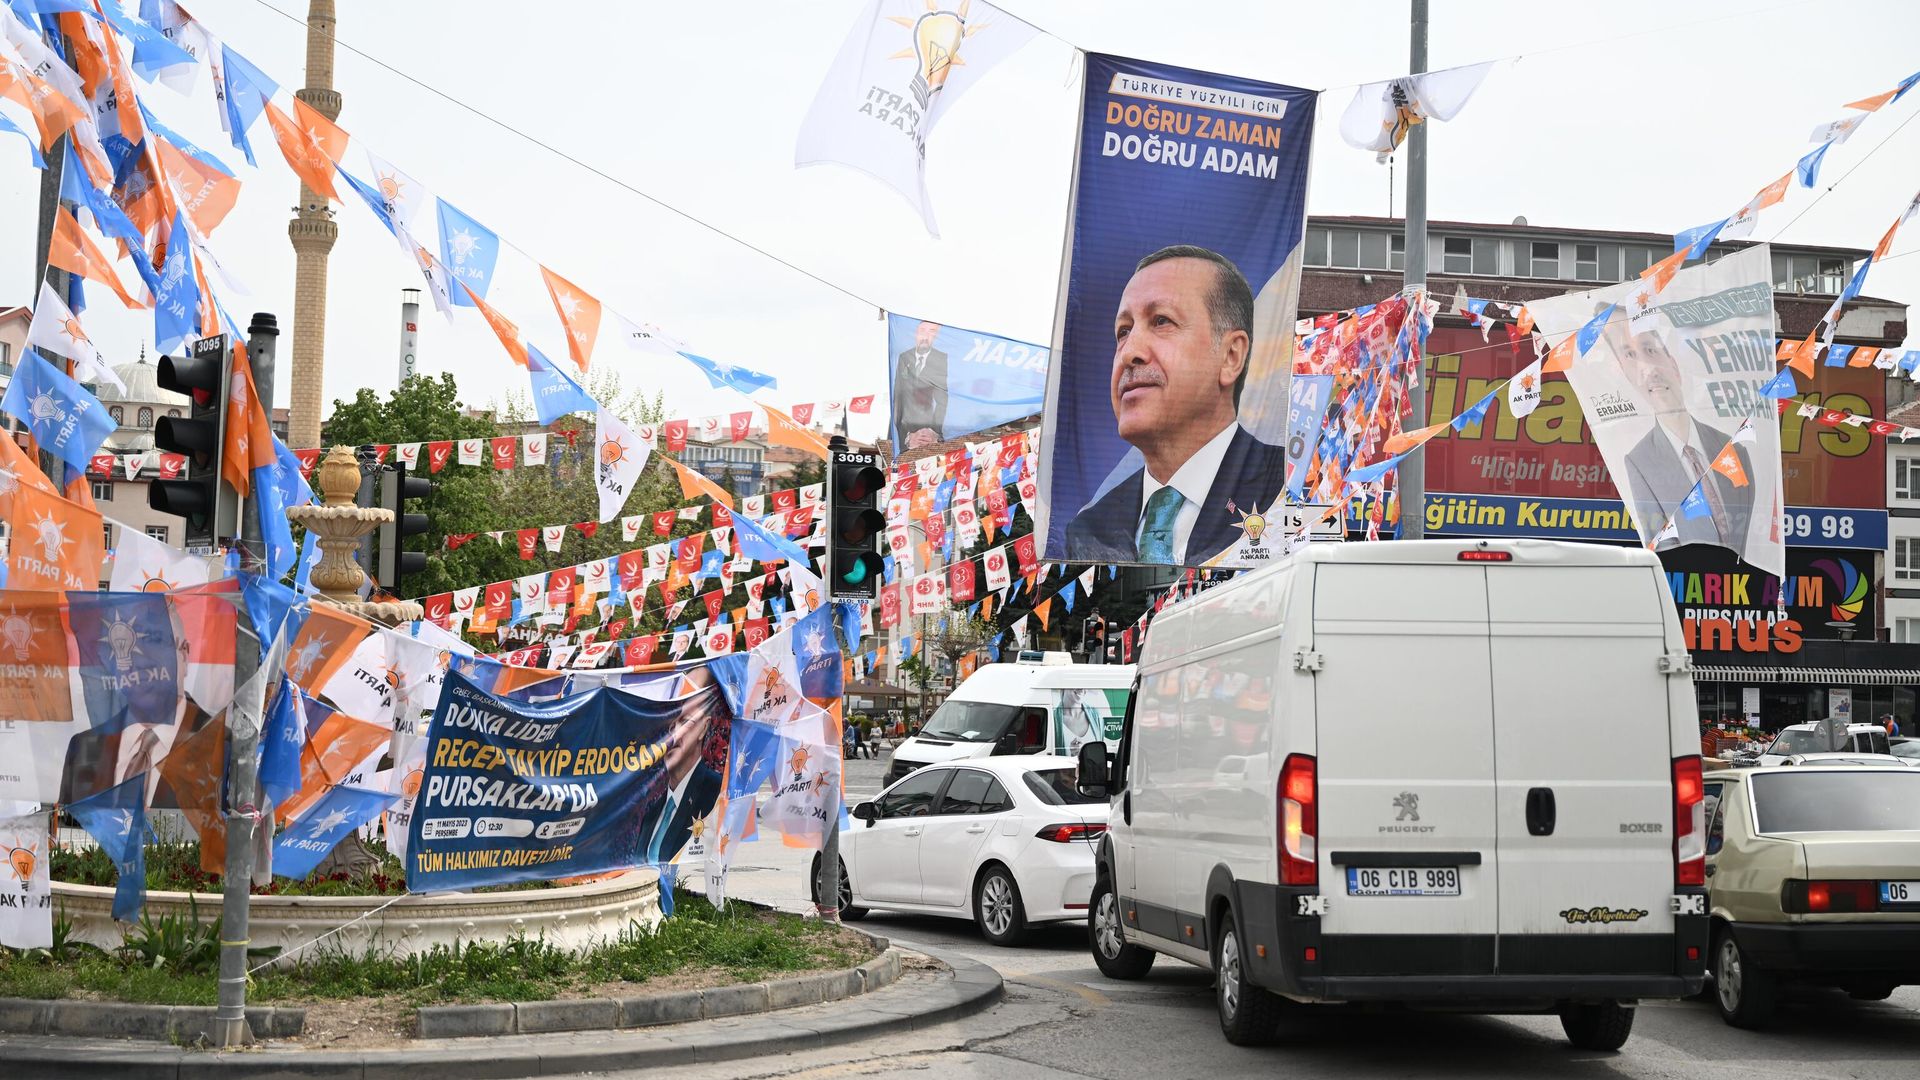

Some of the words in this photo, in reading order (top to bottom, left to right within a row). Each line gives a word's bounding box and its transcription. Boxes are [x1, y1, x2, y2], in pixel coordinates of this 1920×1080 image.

[1122, 78, 1182, 98] TÜRKİYE
[1190, 90, 1245, 109] YÜZYILI
[1252, 100, 1279, 114] İÇİN
[1106, 101, 1192, 135] DOĞRU
[1195, 115, 1281, 149] ZAMAN
[1102, 131, 1197, 168] DOĞRU
[1200, 146, 1279, 180] ADAM
[197, 338, 220, 353] 3095
[1596, 403, 1636, 417] ERBAKAN
[838, 453, 873, 464] 3095
[1821, 515, 1855, 539] 98
[1763, 575, 1823, 608] AVM
[503, 718, 566, 743] LİDERİ
[433, 738, 506, 772] RECEP
[506, 743, 572, 777] TAYYİP
[573, 740, 667, 776] ERDOĞAN
[425, 775, 598, 813] PURSAKLAR'DA
[787, 780, 812, 794] PARTİ
[488, 823, 503, 831] 12:30
[1620, 823, 1663, 833] BOXER
[297, 839, 330, 853] PARTİ
[418, 850, 442, 873] TÜM
[446, 850, 500, 871] HALKIMIZ
[1361, 870, 1380, 888] 06
[1389, 870, 1418, 888] CIB
[1426, 870, 1456, 888] 989
[1, 894, 17, 908] AK
[1890, 884, 1908, 900] 06
